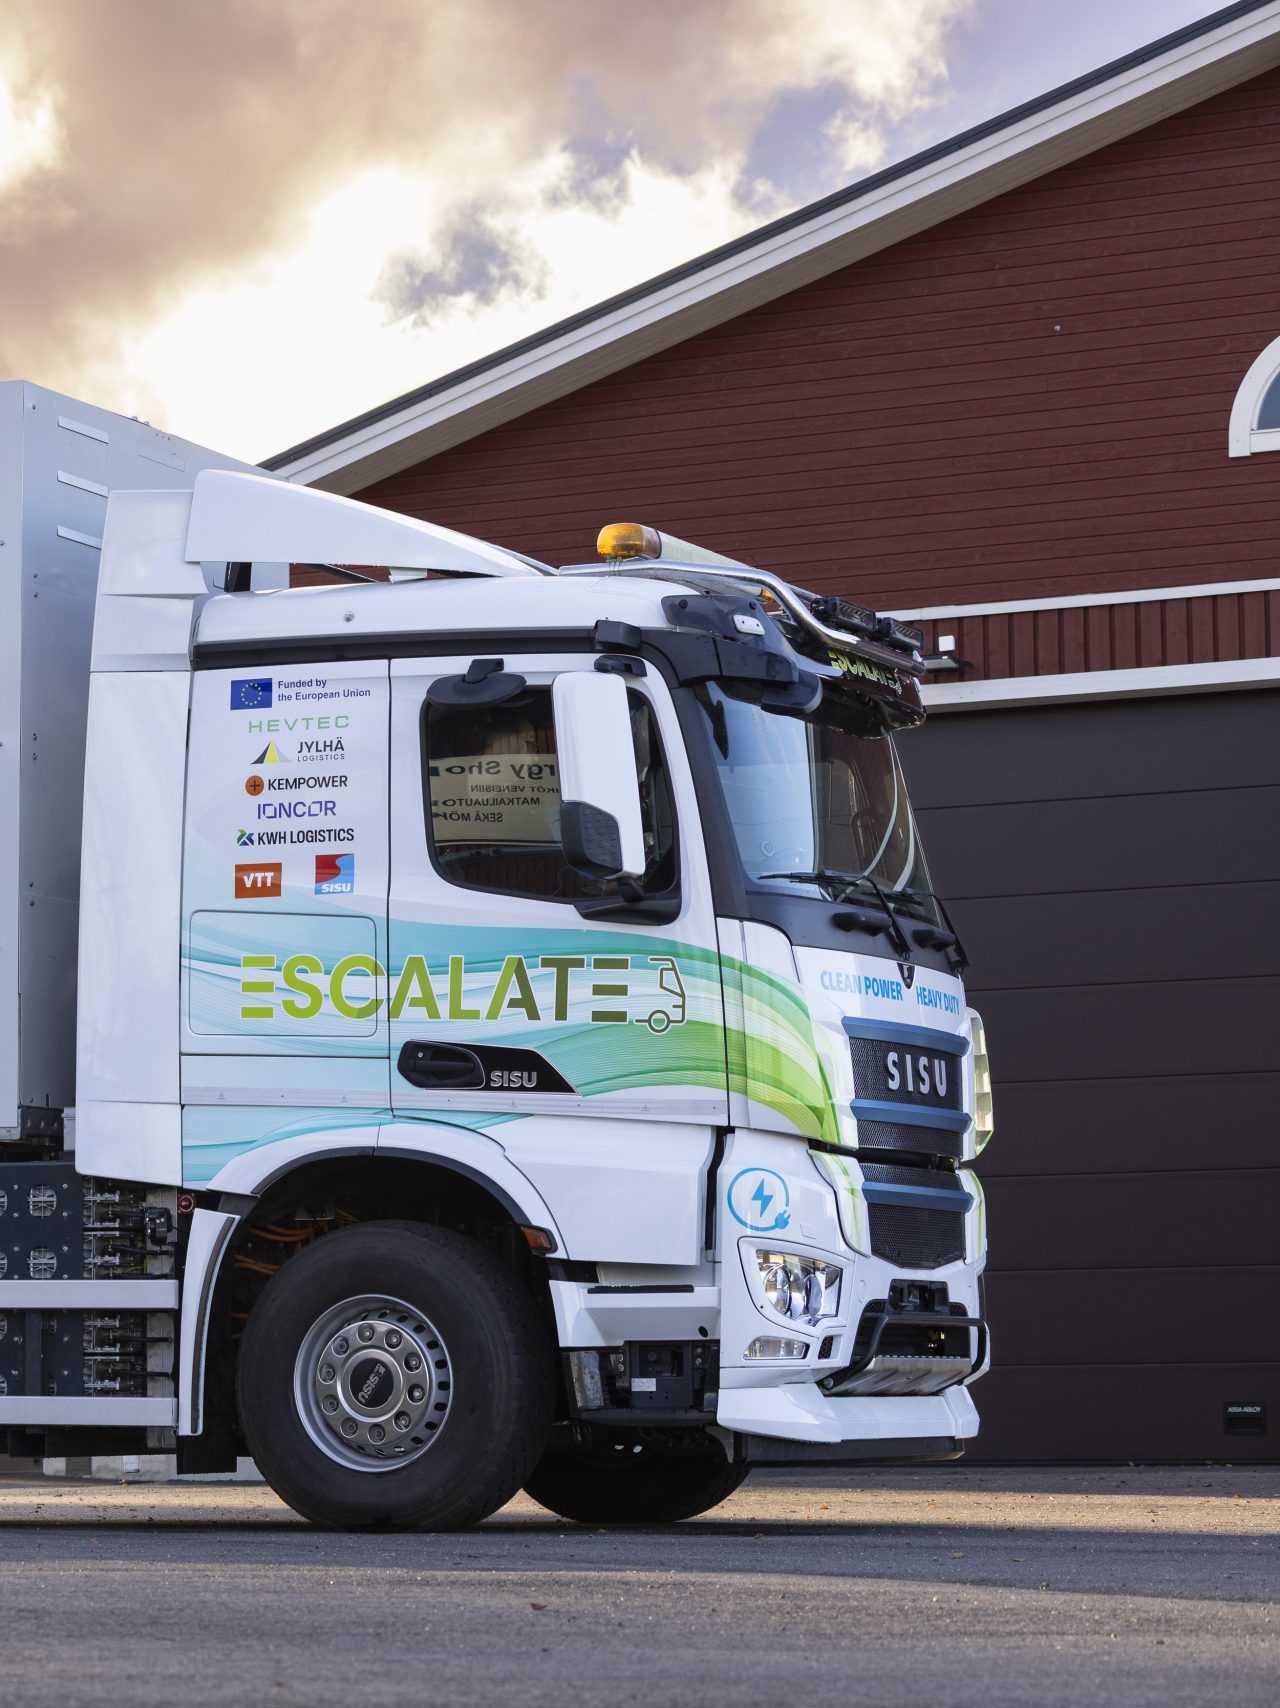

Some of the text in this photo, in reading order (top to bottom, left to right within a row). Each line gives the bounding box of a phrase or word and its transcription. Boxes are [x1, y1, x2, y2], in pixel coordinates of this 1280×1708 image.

[278, 679, 327, 689] Funded by
[278, 688, 371, 702] the European Union
[248, 715, 349, 733] HEVTEC
[297, 737, 345, 753] JYLHÄ
[297, 753, 345, 762] LOGISTICS
[268, 775, 348, 791] KEMPOWER
[258, 800, 336, 819] IONCOR
[258, 828, 355, 845] KWH LOGISTICS
[243, 872, 274, 888] VTT
[321, 882, 351, 893] SISU
[239, 954, 630, 1024] ESCALATE
[820, 970, 960, 1015] CLEAN POWER HEAVY DUTY
[489, 1069, 538, 1088] SISU
[887, 1051, 947, 1097] SISU
[358, 1372, 380, 1404] SISU
